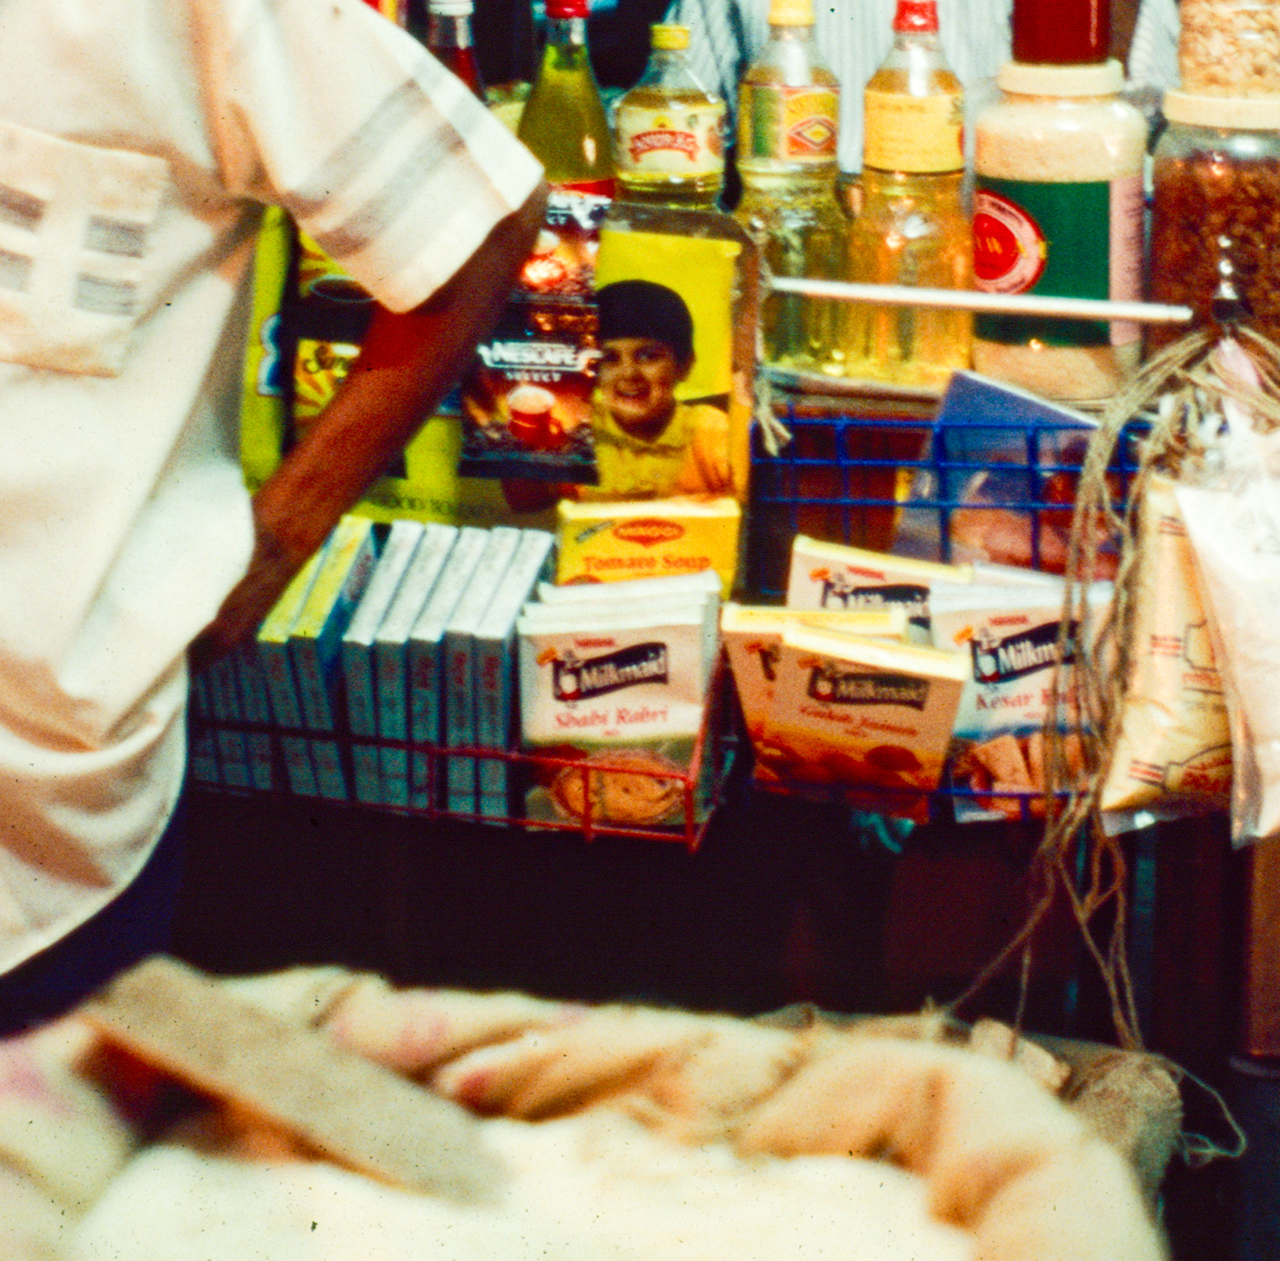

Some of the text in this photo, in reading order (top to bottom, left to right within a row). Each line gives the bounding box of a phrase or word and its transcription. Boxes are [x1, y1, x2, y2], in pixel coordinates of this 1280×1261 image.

[583, 555, 711, 574] Tomato Soup
[580, 649, 668, 692] Milkmaid
